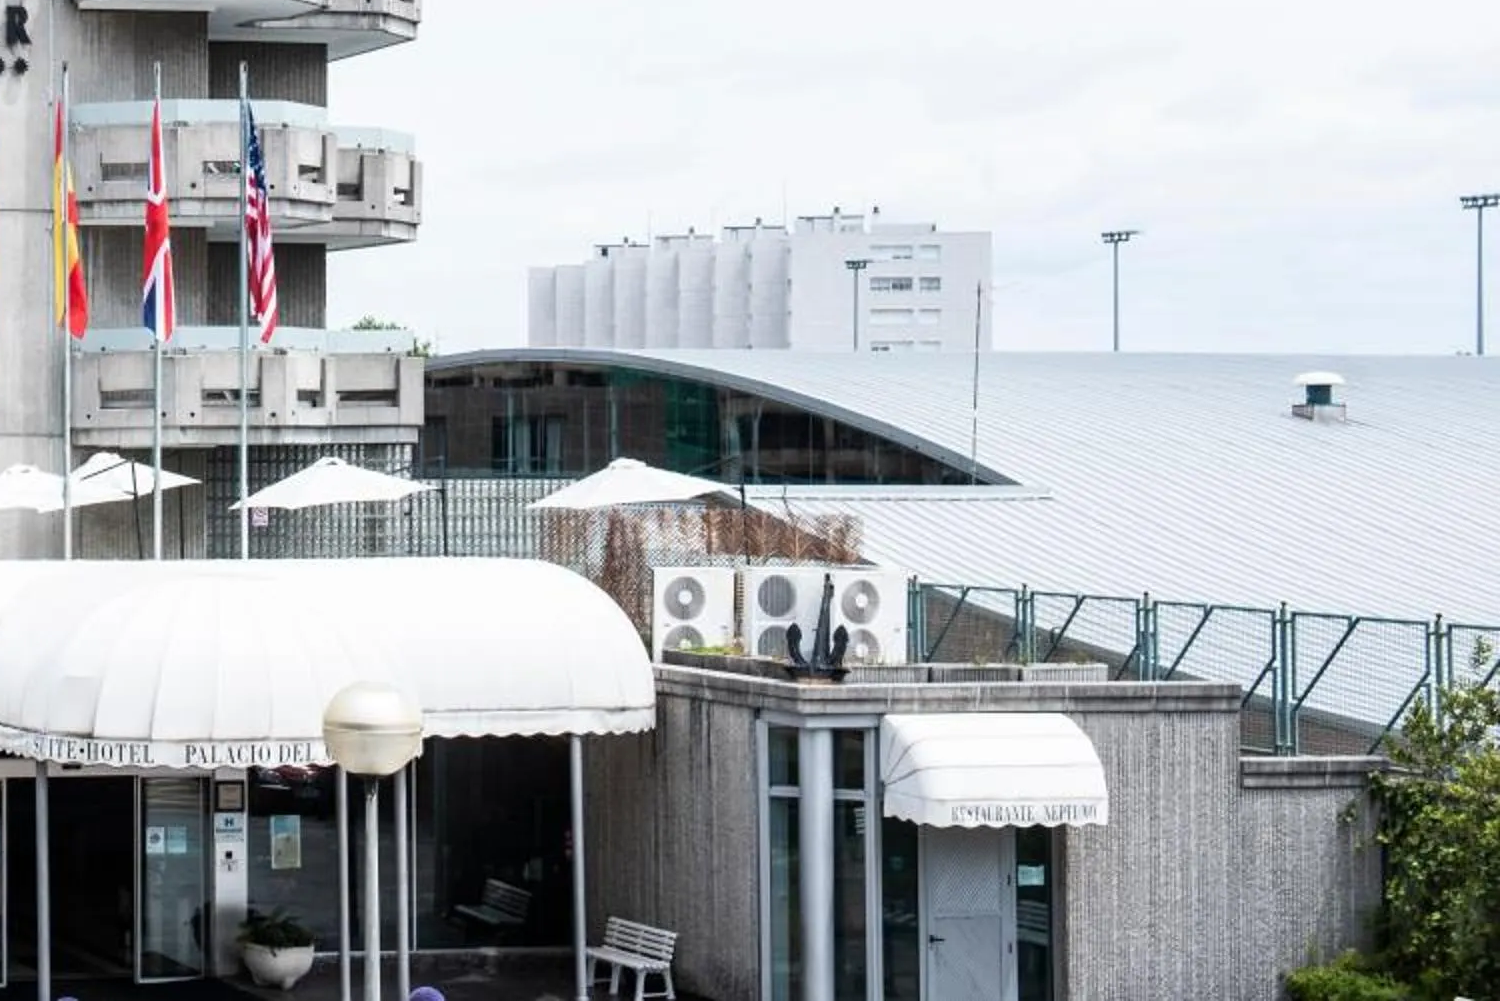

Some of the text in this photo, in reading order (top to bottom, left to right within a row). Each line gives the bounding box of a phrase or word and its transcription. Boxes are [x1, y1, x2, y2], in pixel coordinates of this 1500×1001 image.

[184, 744, 271, 764] PALACIO
[279, 742, 312, 762] DEL
[951, 805, 1035, 823] RESTAURANTE
